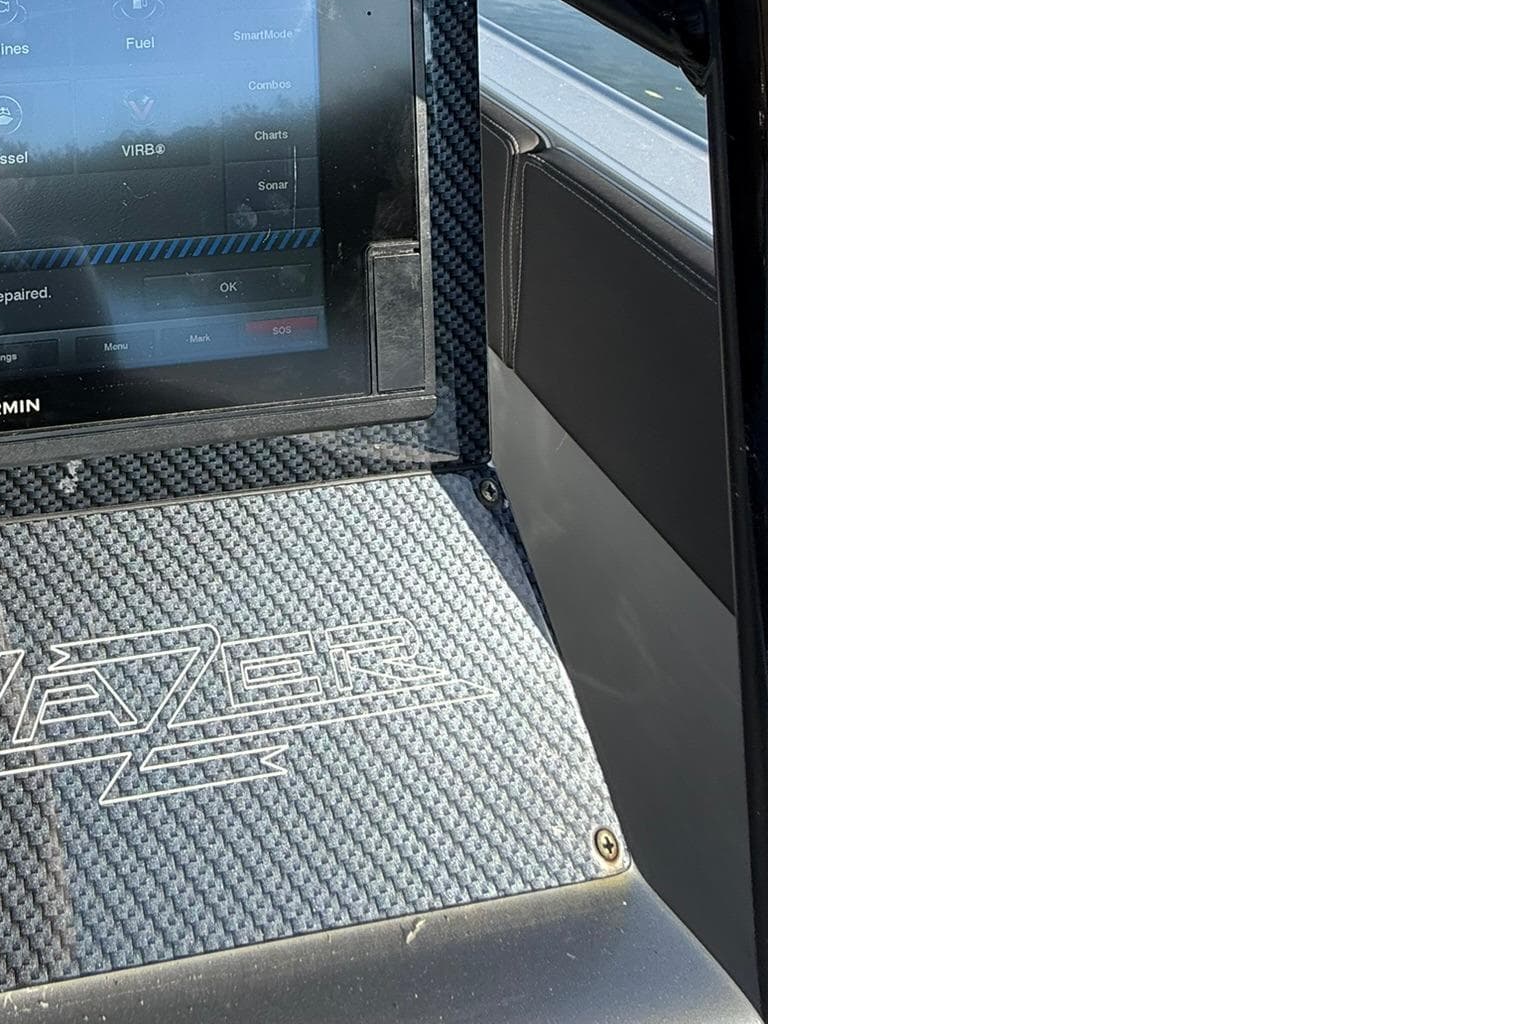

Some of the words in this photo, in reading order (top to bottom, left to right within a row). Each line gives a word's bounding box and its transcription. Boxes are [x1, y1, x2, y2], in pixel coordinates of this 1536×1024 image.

[126, 35, 155, 49] Fuel
[248, 79, 292, 91] Combos
[254, 130, 288, 141] Charts
[258, 180, 288, 191] Sonar
[220, 281, 238, 293] OK
[272, 325, 292, 335] SOS
[189, 333, 211, 343] Mark
[104, 341, 129, 351] Menu
